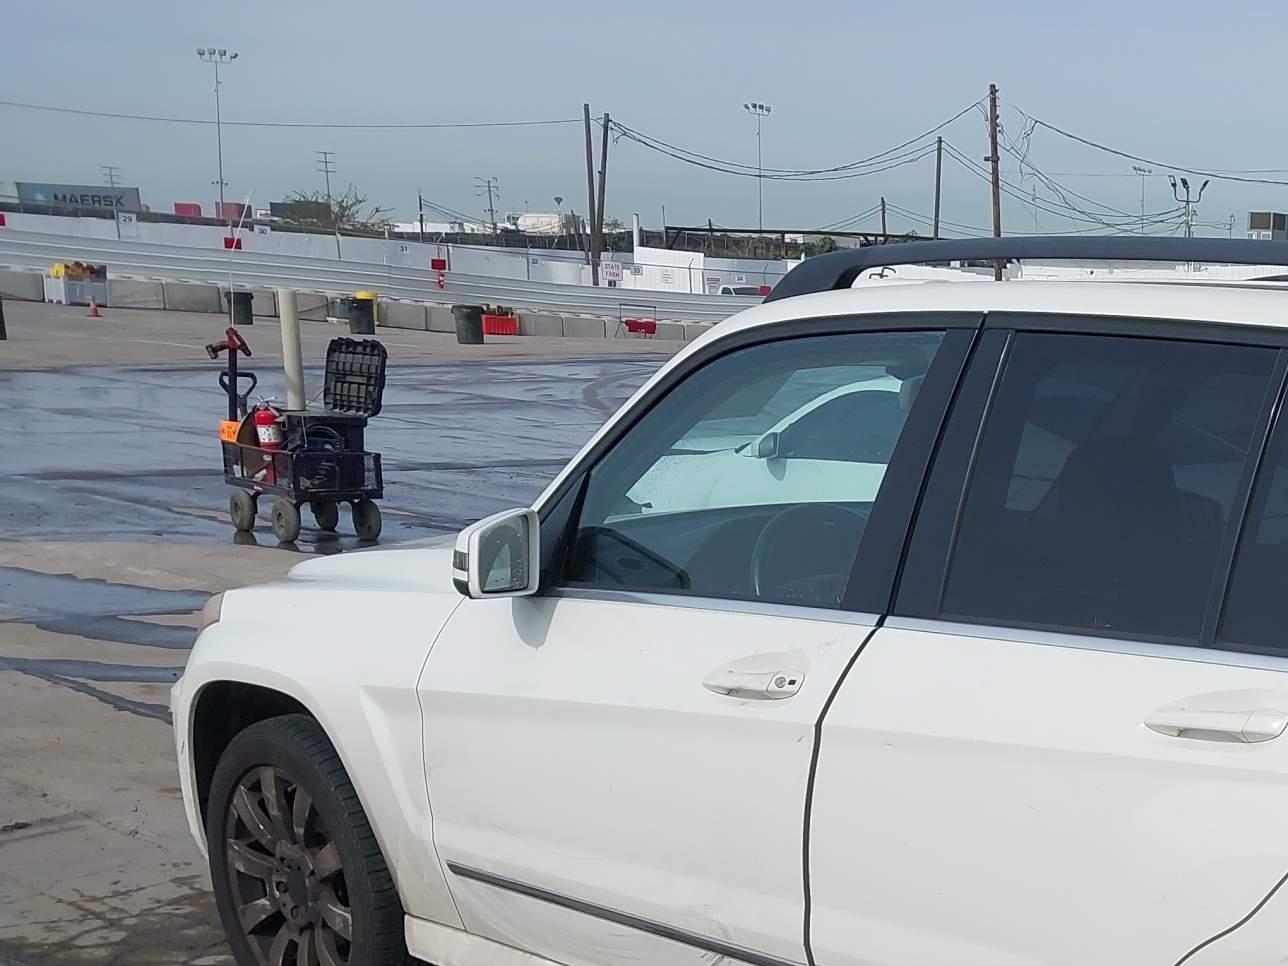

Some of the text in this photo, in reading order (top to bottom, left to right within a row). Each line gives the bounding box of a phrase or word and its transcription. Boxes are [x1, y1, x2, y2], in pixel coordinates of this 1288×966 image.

[53, 192, 125, 208] MAERSK
[122, 215, 133, 223] 29
[604, 263, 620, 271] STATE
